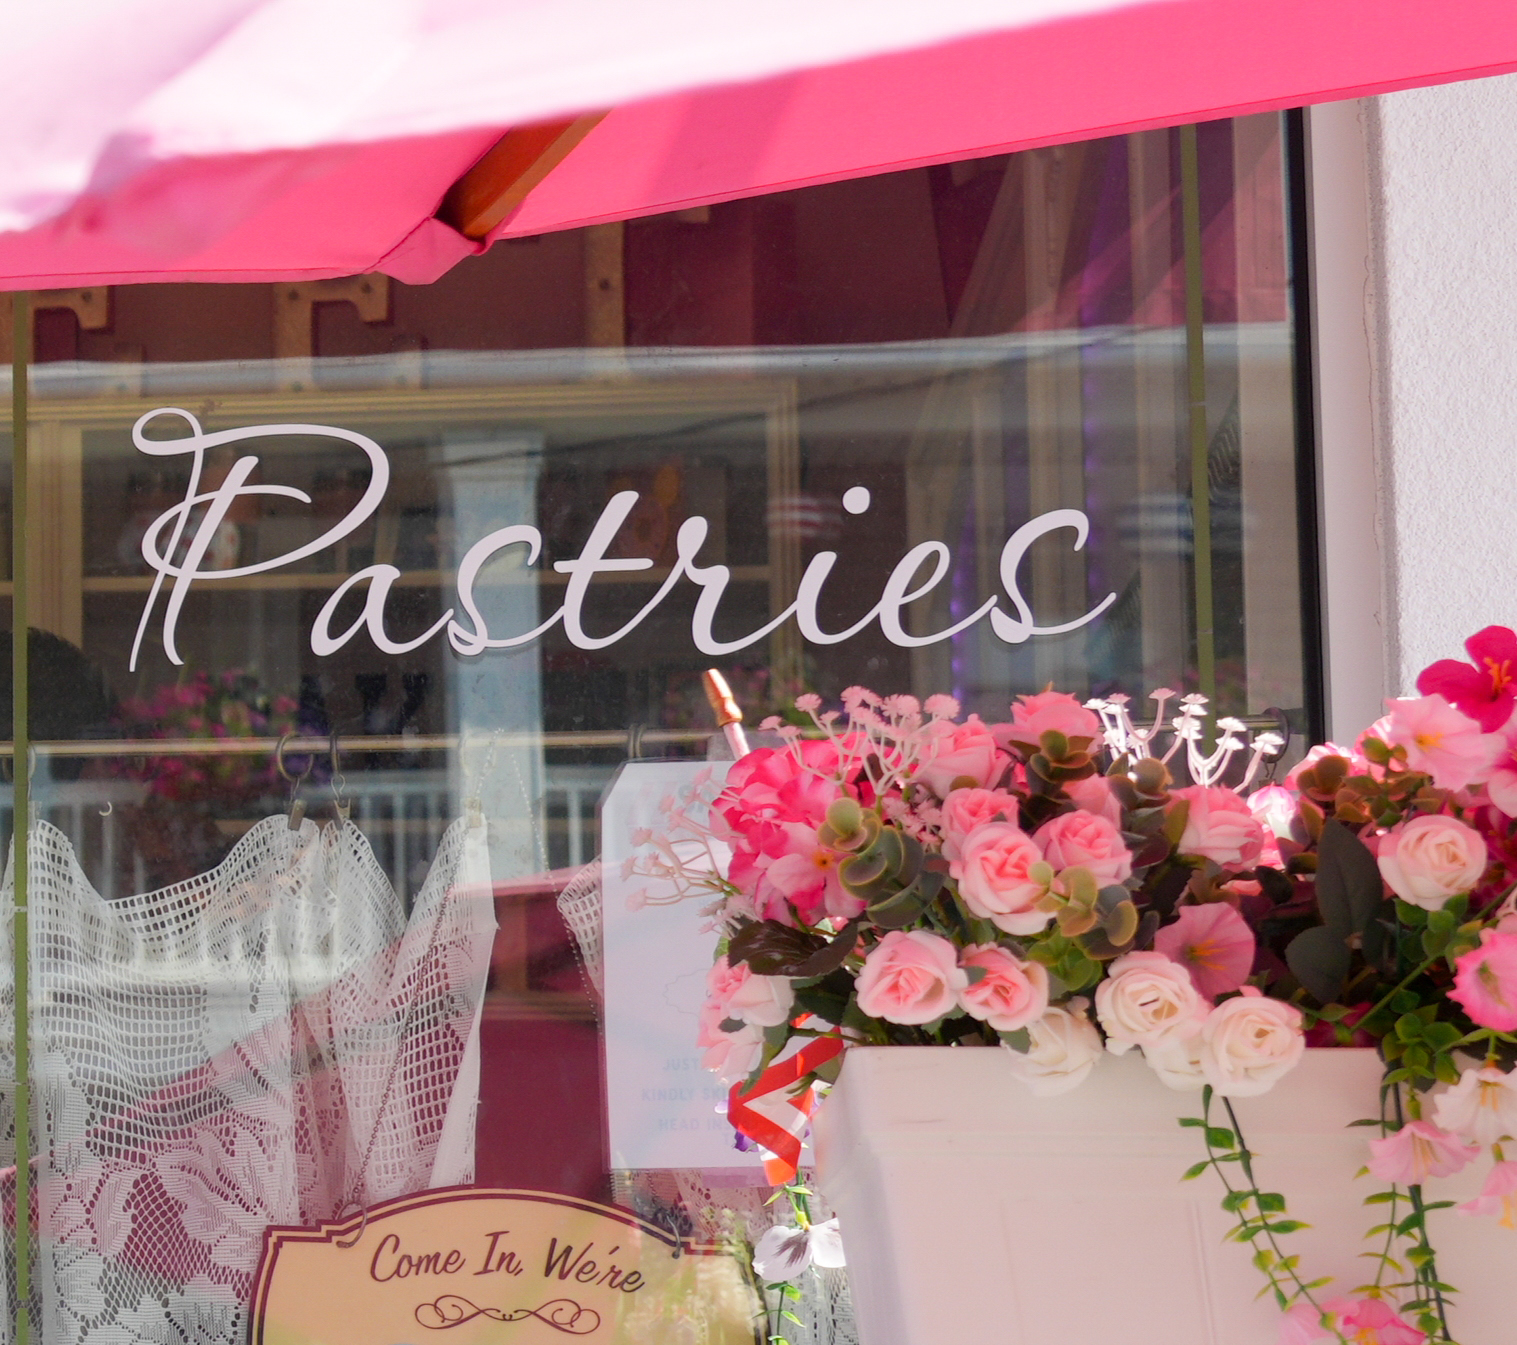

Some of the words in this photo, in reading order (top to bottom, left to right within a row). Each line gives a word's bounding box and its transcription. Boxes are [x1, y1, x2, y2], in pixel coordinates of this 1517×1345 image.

[128, 407, 1117, 672] Pastries
[369, 1233, 466, 1283] Come
[473, 1230, 525, 1278] In,
[543, 1237, 646, 1294] We're
